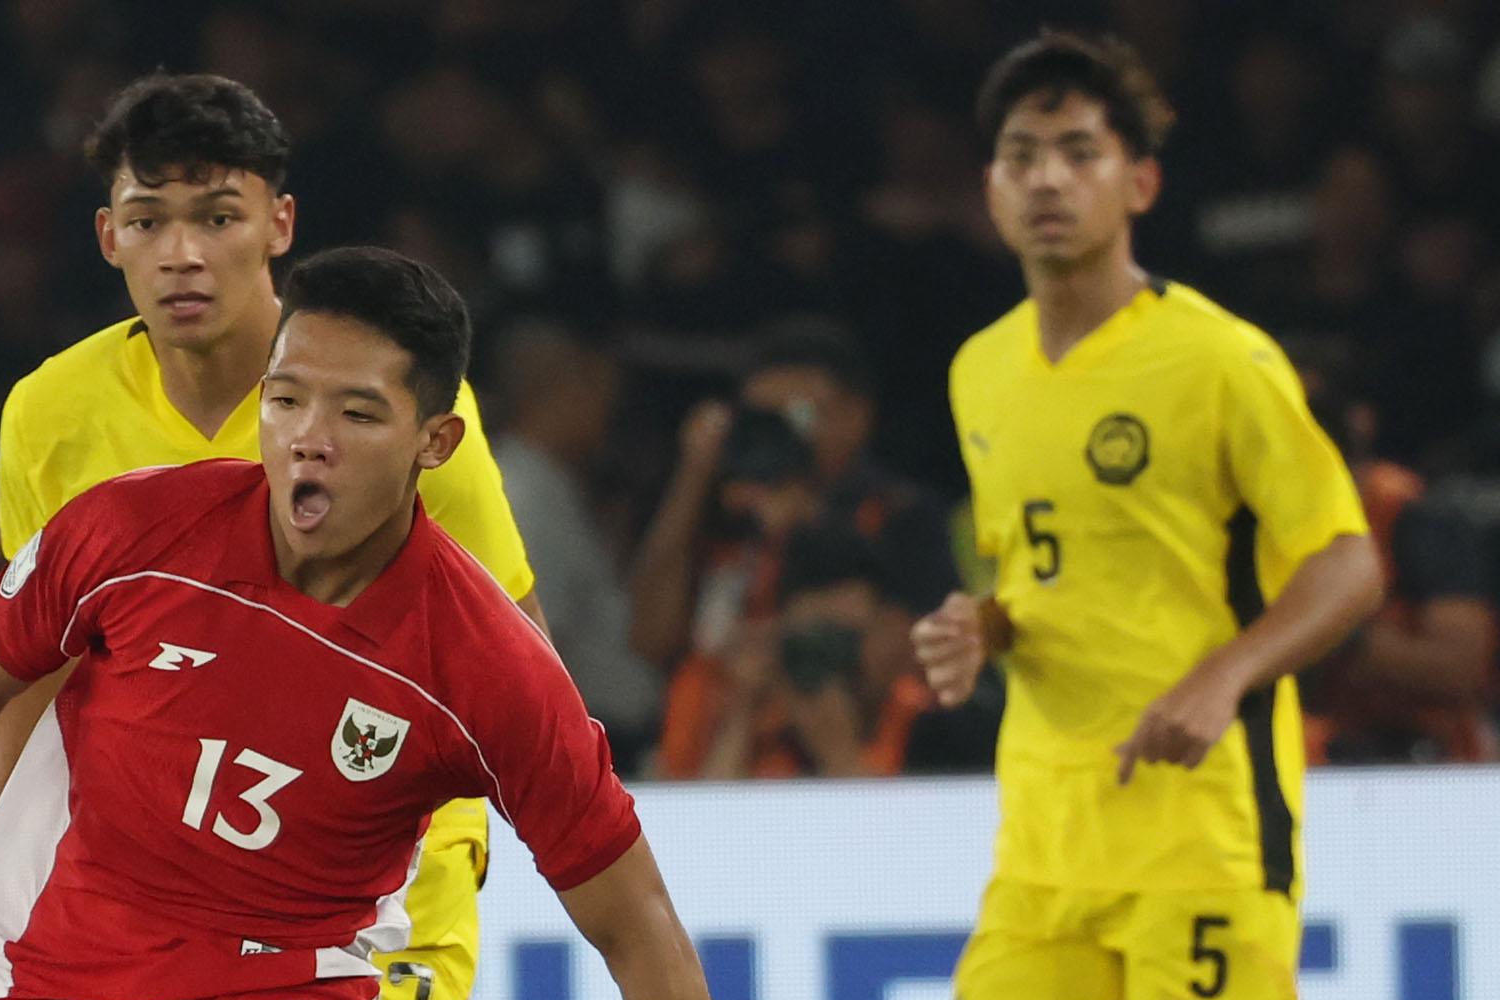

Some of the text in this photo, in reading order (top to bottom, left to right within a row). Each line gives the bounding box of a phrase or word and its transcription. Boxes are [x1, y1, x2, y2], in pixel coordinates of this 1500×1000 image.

[1023, 500, 1061, 581] 5
[183, 738, 303, 851] 13
[1188, 915, 1229, 999] 5
